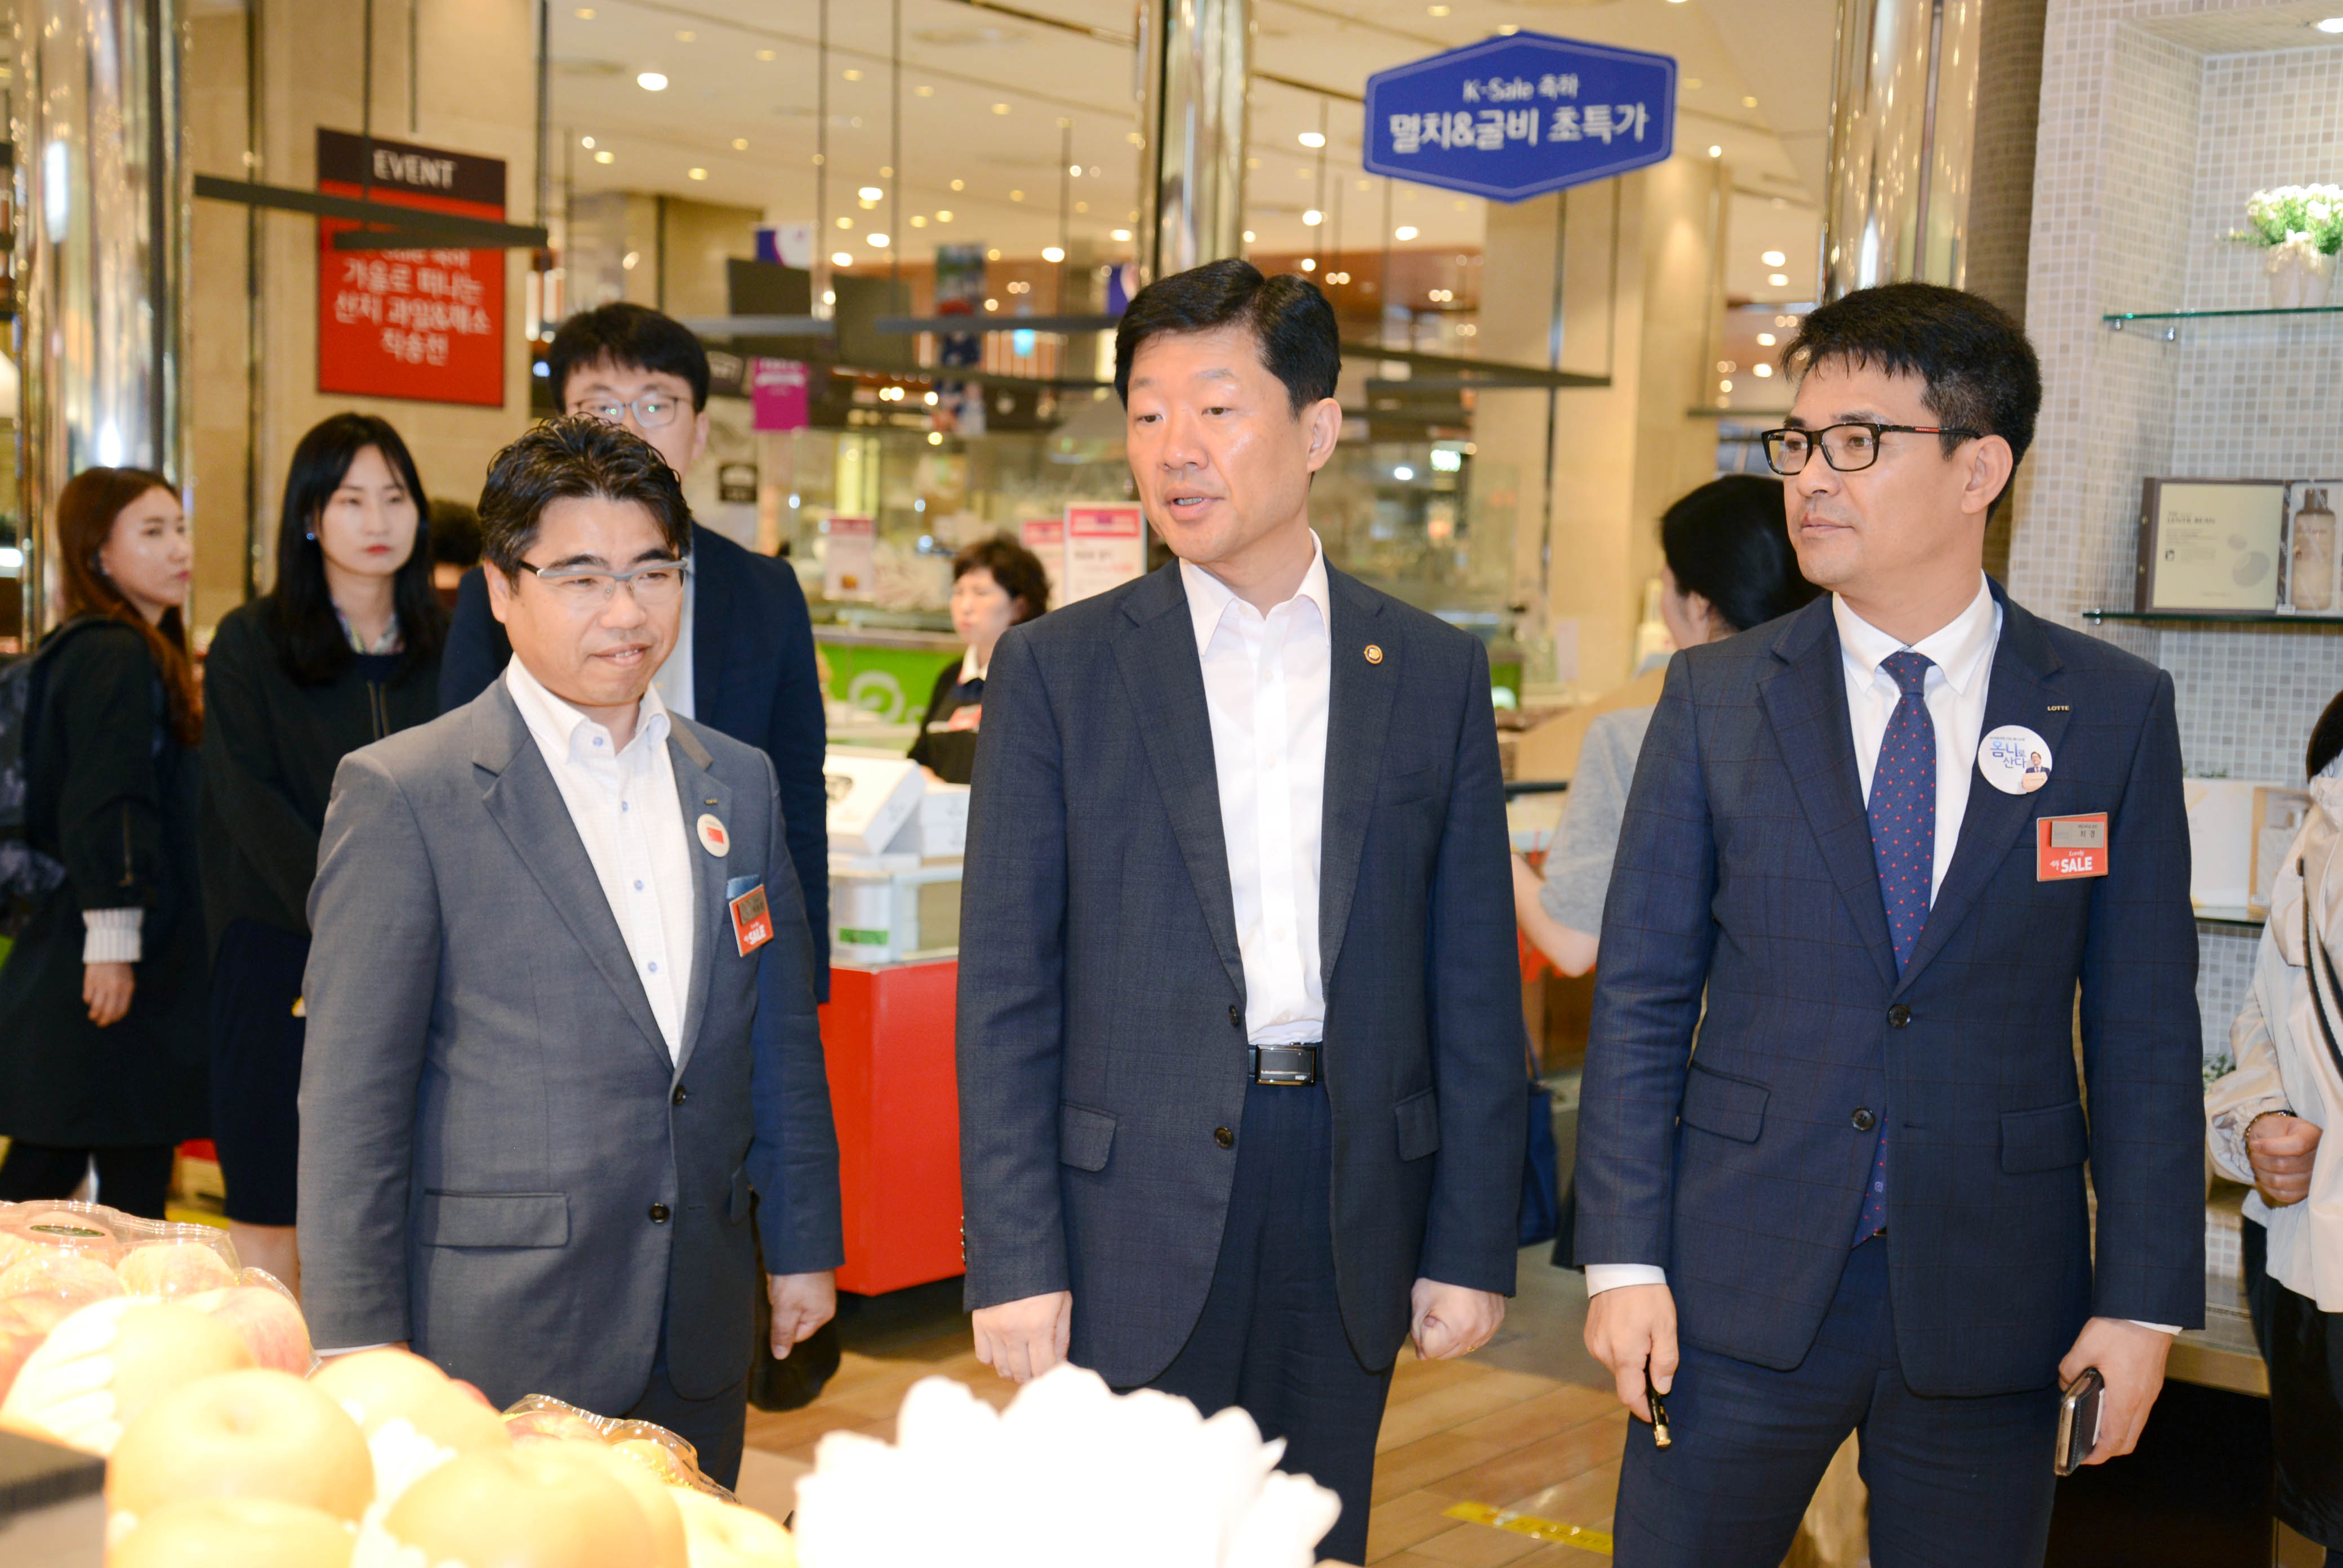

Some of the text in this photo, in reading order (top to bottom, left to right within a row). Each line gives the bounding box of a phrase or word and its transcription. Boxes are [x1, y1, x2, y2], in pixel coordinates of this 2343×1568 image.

[1463, 76, 1534, 103] K-Sale
[1389, 101, 1649, 154] 멸치&굴비 초특가
[373, 148, 456, 189] EVENT
[342, 257, 413, 295] 가을로
[1989, 740, 2026, 758] 옴니로
[2002, 756, 2027, 769] 산다
[2060, 856, 2093, 874] SALE
